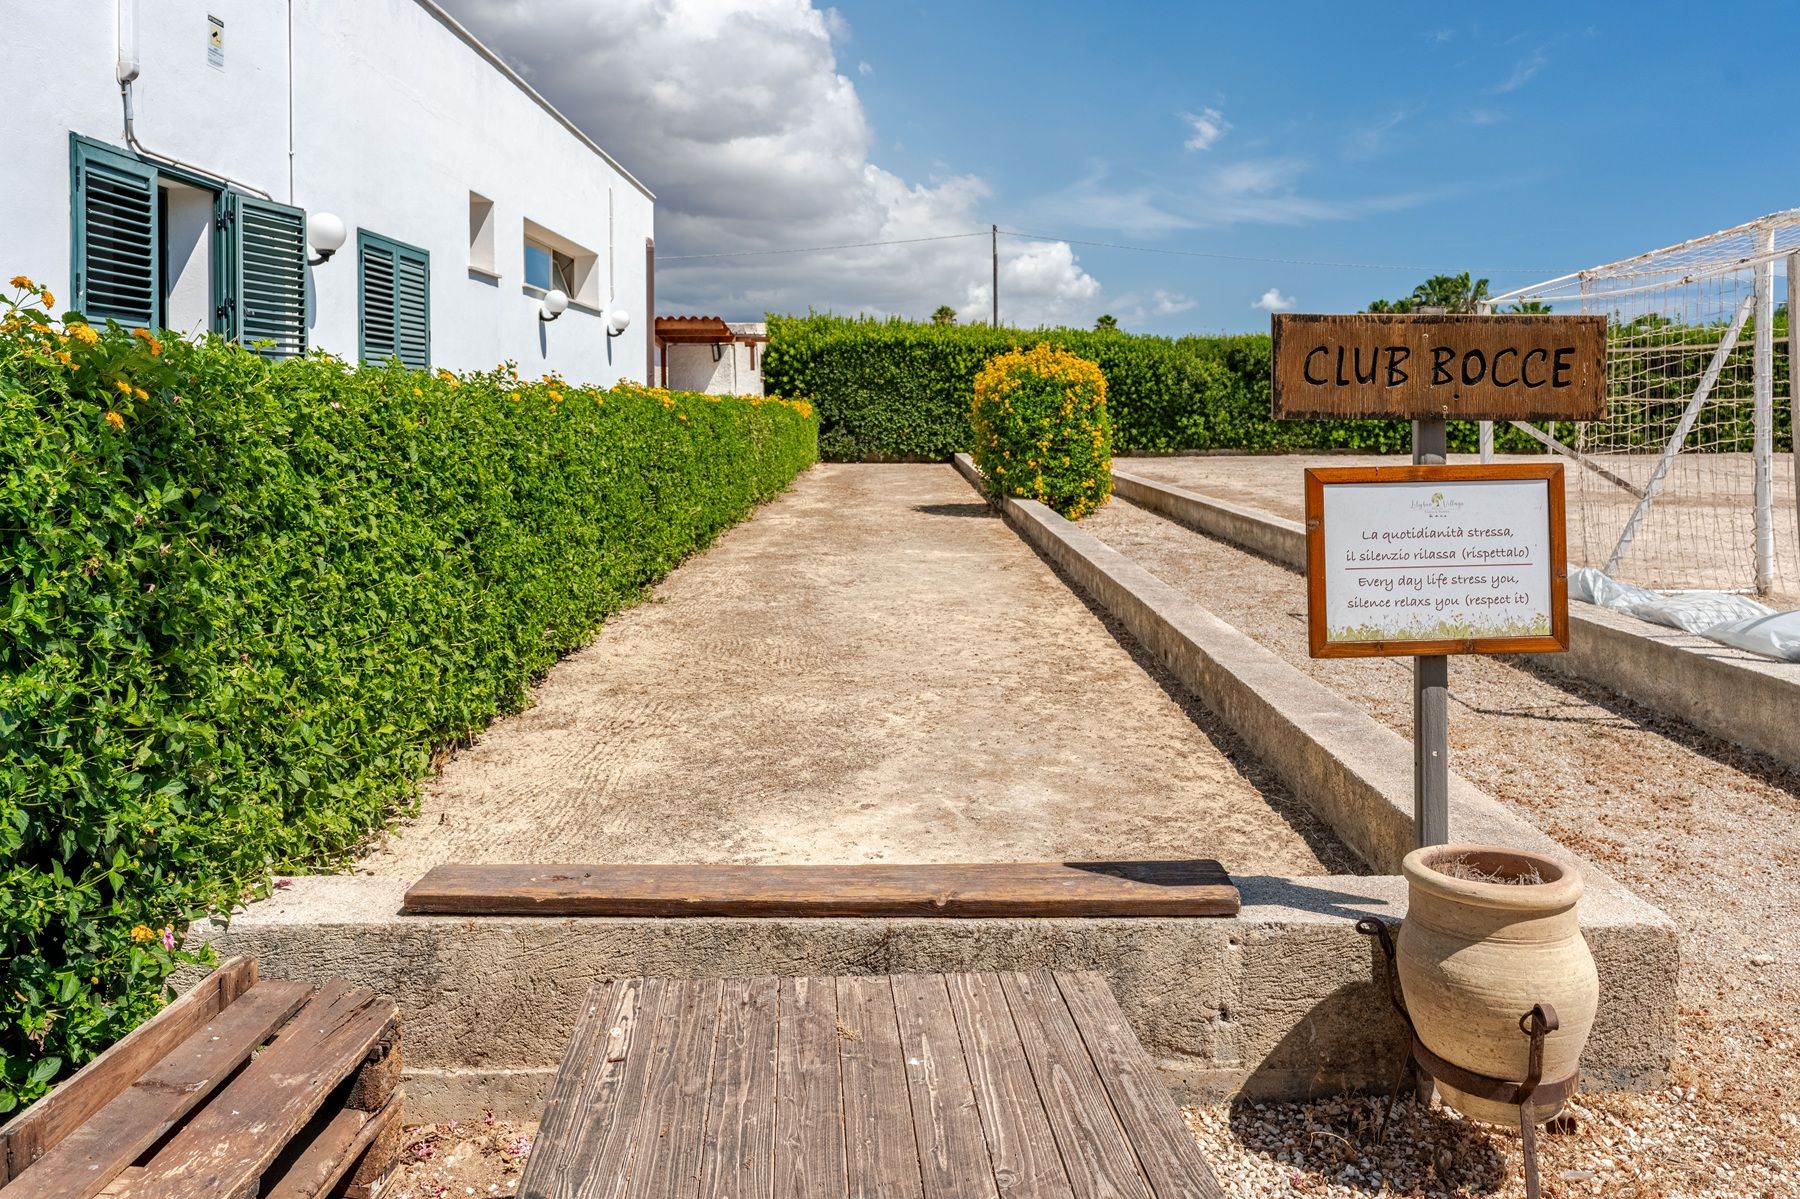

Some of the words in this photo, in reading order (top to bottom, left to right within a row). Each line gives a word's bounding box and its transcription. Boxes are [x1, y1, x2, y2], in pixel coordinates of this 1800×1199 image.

[1303, 345, 1410, 388] CLUB
[1429, 346, 1576, 388] BOCCE
[1362, 530, 1379, 540] La
[1382, 526, 1464, 544] quotidianità
[1467, 527, 1514, 539] stressa,
[1346, 550, 1356, 562] il
[1359, 548, 1410, 561] silenzio
[1413, 547, 1456, 560] rilassa
[1462, 546, 1529, 562] (rispettalo)
[1358, 576, 1394, 591] Every
[1398, 574, 1423, 590] day
[1427, 573, 1448, 588] life
[1451, 574, 1487, 585] stress
[1491, 574, 1519, 589] you,
[1347, 596, 1391, 608] silence
[1394, 596, 1431, 607] relaxs
[1435, 597, 1460, 611] you
[1465, 594, 1511, 609] (respect
[1514, 592, 1529, 606] it)
